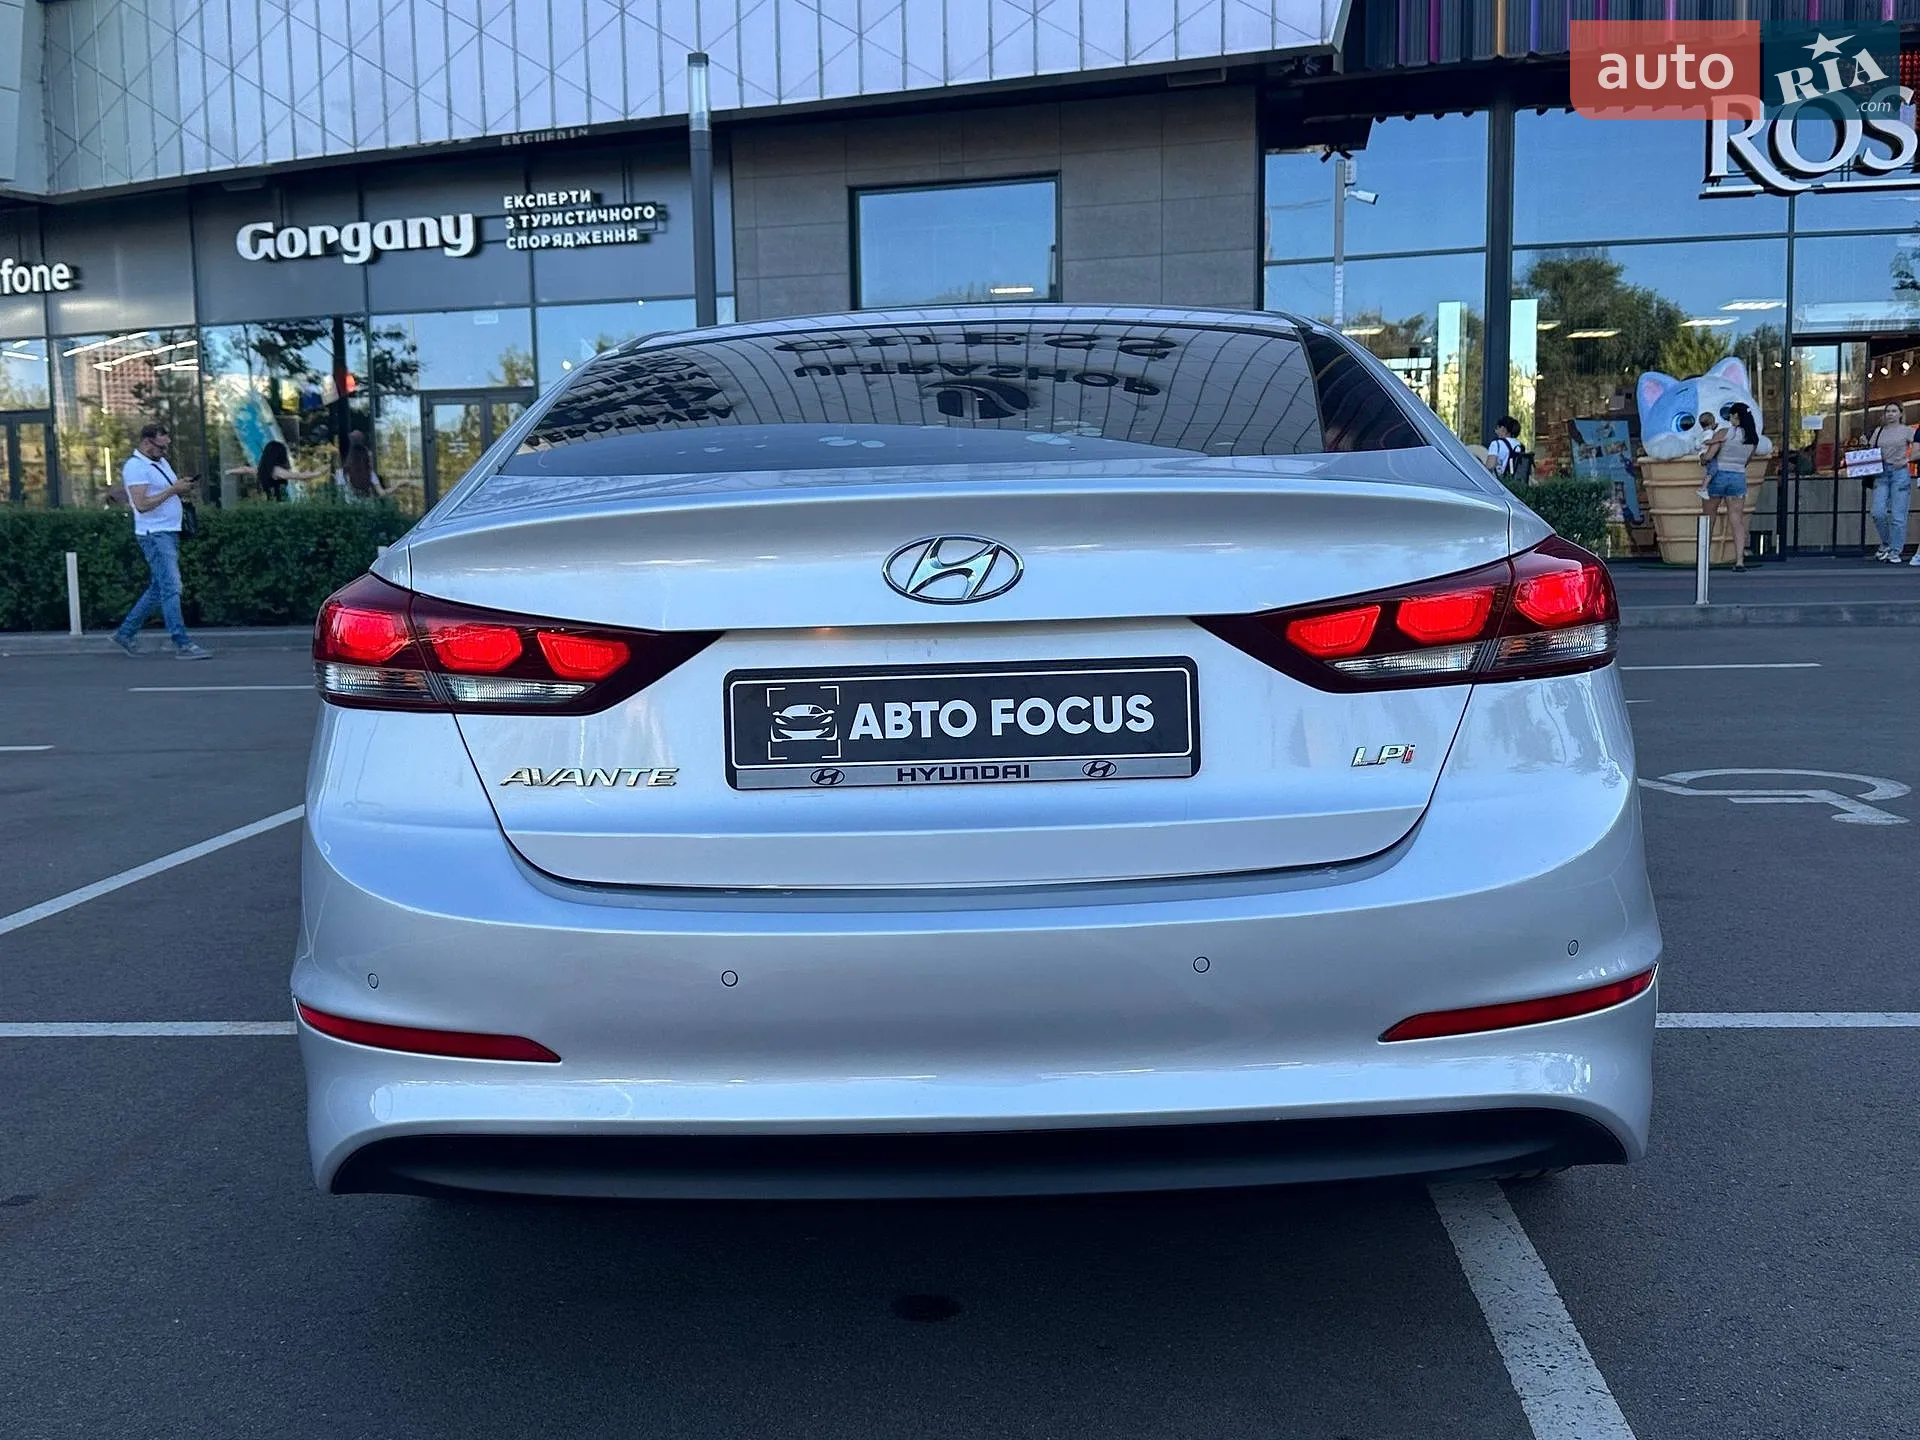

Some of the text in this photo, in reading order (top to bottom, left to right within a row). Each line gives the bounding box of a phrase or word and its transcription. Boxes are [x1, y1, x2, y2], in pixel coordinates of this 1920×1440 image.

[503, 189, 592, 209] ЕКСПЕРТИ
[520, 205, 656, 229] ТУРИСТИЧНОГО
[236, 213, 474, 264] Gorgany
[506, 228, 638, 249] СПОРЯДЖЕННЯ
[849, 694, 1155, 741] АВТО FOCUS
[1351, 743, 1416, 768] LPi
[500, 768, 680, 787] AVANTE
[897, 764, 1030, 782] HYUNDAI
